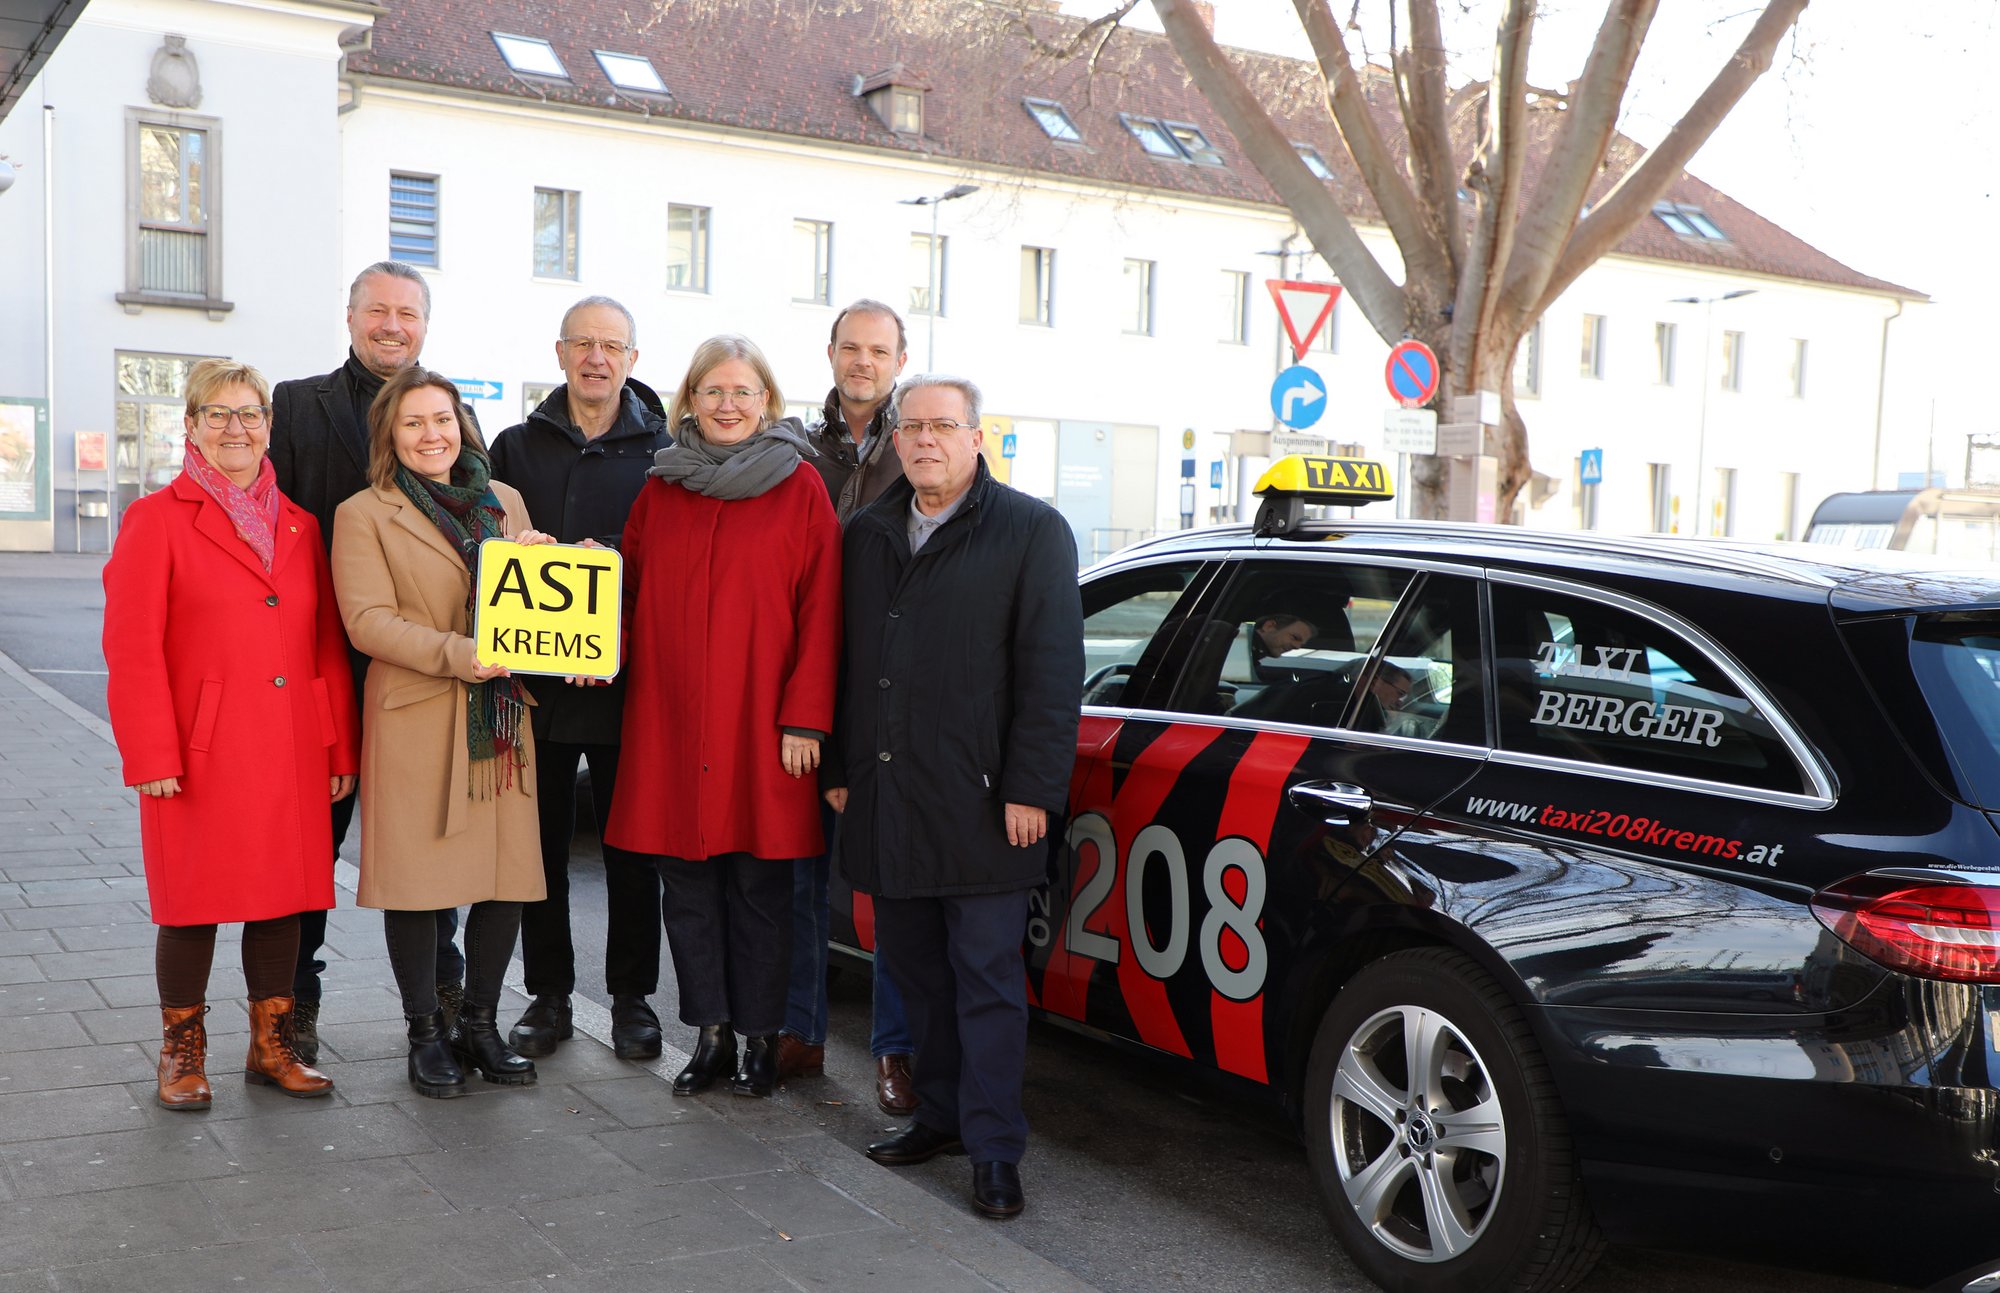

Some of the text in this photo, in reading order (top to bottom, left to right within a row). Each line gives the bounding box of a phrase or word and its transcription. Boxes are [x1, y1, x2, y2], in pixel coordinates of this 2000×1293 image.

[1273, 435, 1325, 448] Ausgenommen
[1308, 460, 1382, 489] TAXI
[489, 558, 611, 615] AST
[492, 627, 602, 660] KREMS
[1535, 641, 1643, 682] TAXI
[1530, 690, 1725, 748] BERGER
[1466, 796, 1784, 868] www.taxi208krems.at
[1065, 812, 1268, 1000] 208
